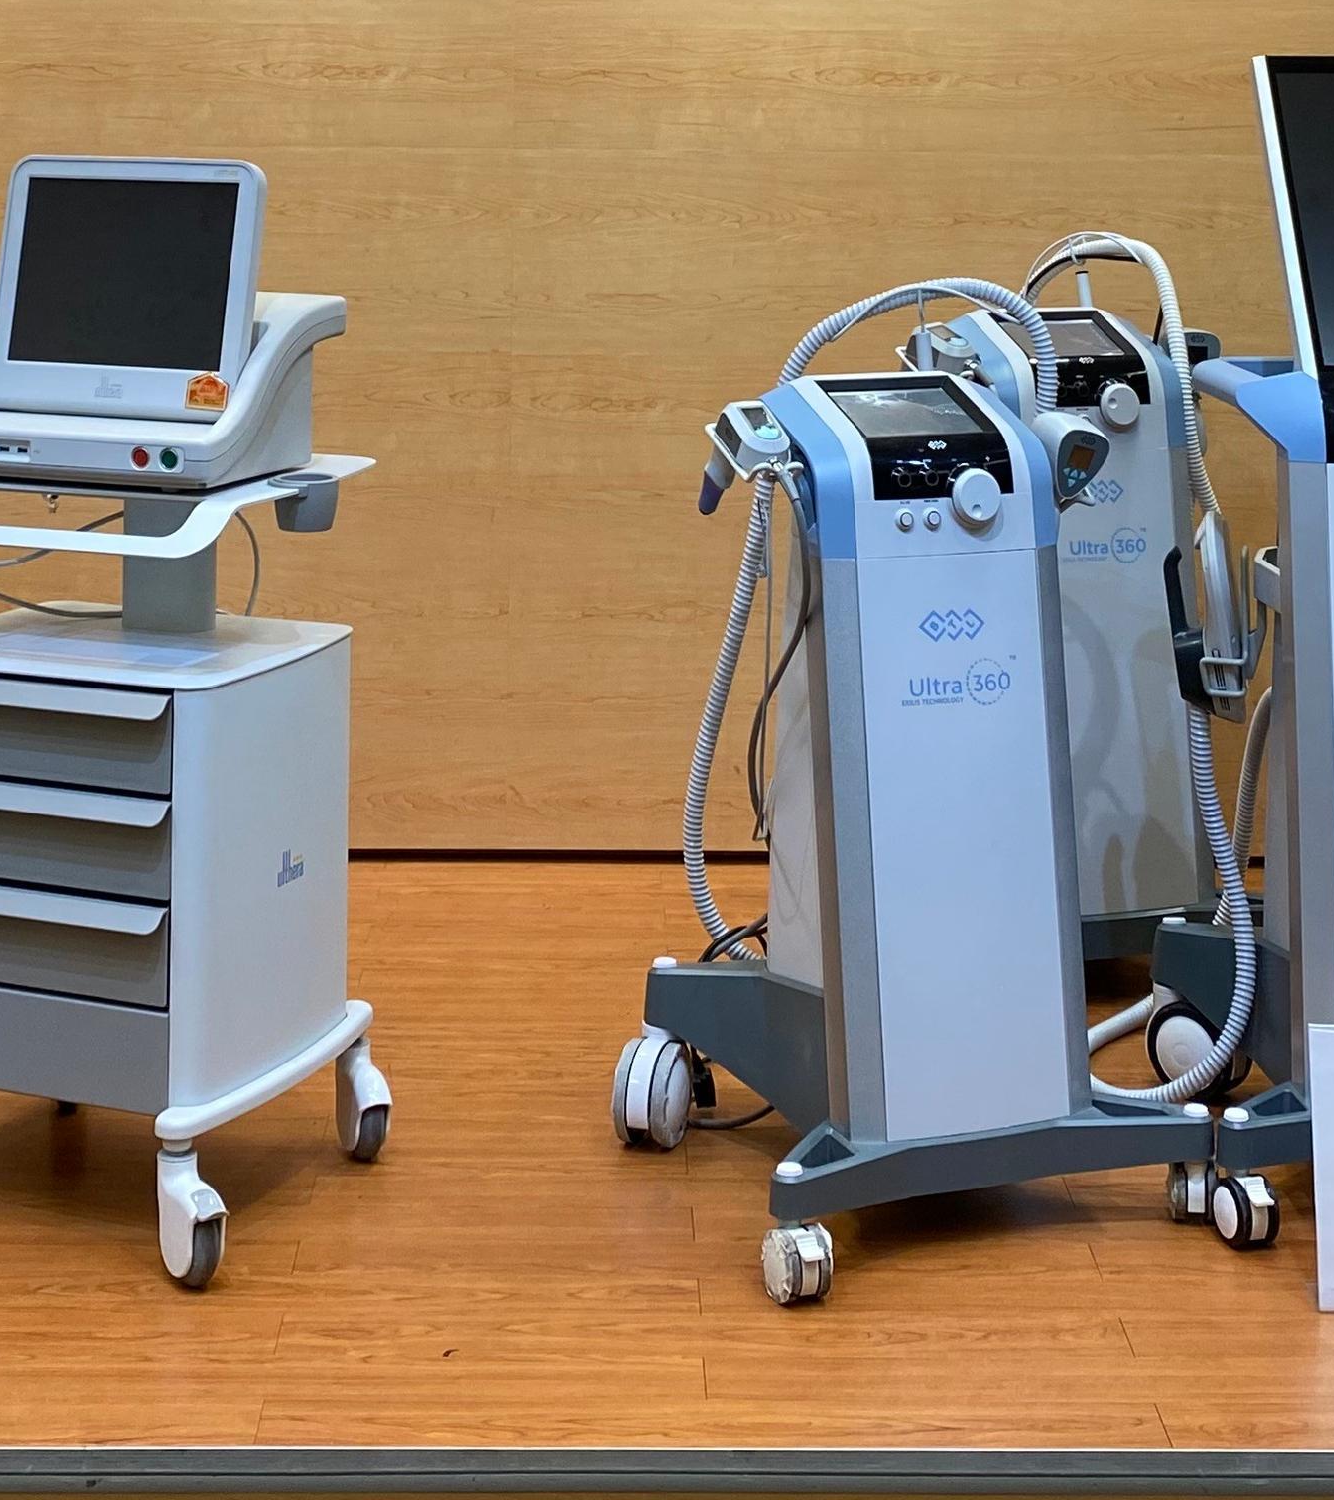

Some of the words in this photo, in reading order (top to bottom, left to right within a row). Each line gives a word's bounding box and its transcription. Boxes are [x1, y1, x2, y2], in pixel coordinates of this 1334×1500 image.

[1069, 539, 1108, 556] Ultra
[1115, 537, 1147, 554] 360
[909, 676, 963, 697] Ultra
[972, 671, 1011, 692] 360
